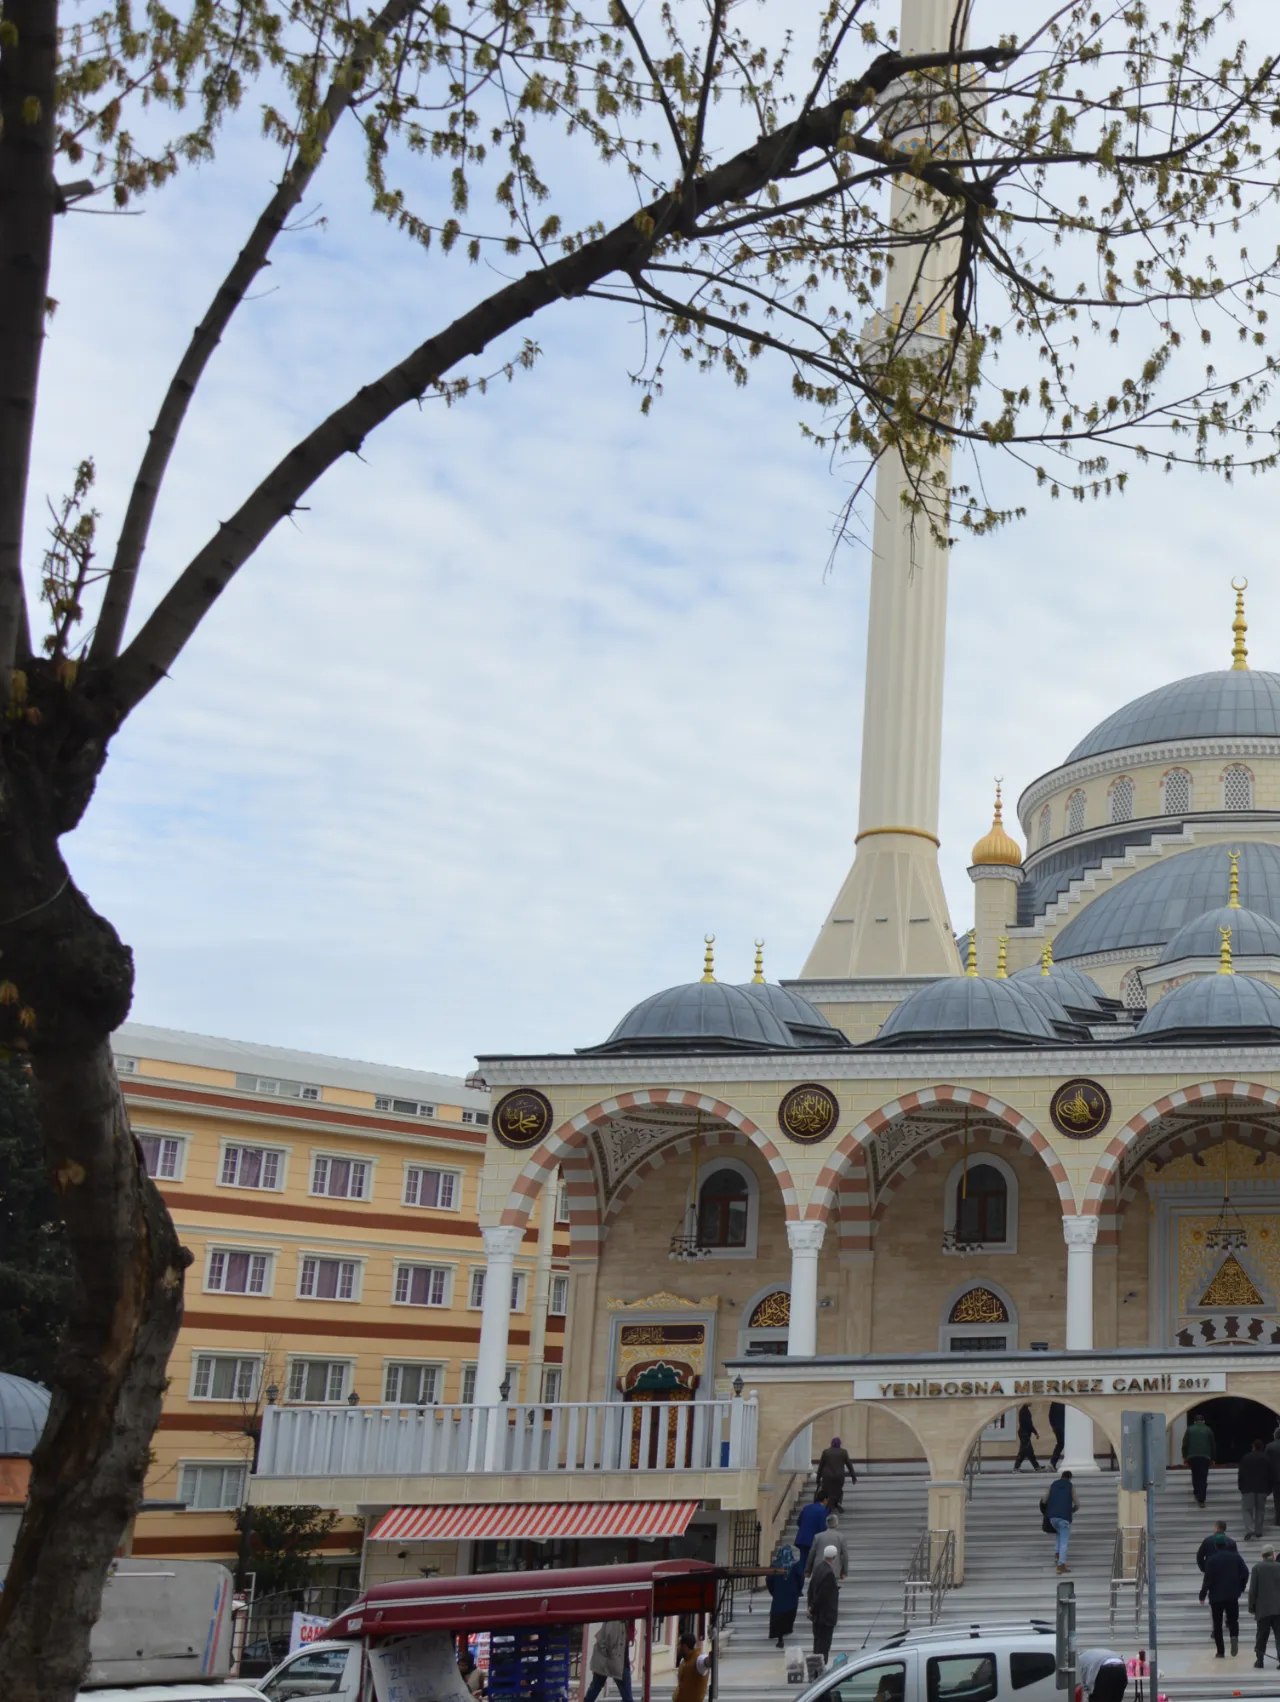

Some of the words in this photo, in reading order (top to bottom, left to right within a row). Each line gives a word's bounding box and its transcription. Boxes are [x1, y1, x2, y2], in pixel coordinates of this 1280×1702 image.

[878, 1379, 1004, 1397] YENİBOSNA
[1014, 1379, 1104, 1395] MERKEZ
[1111, 1373, 1172, 1393] CAMİİ
[1177, 1378, 1211, 1390] 2017
